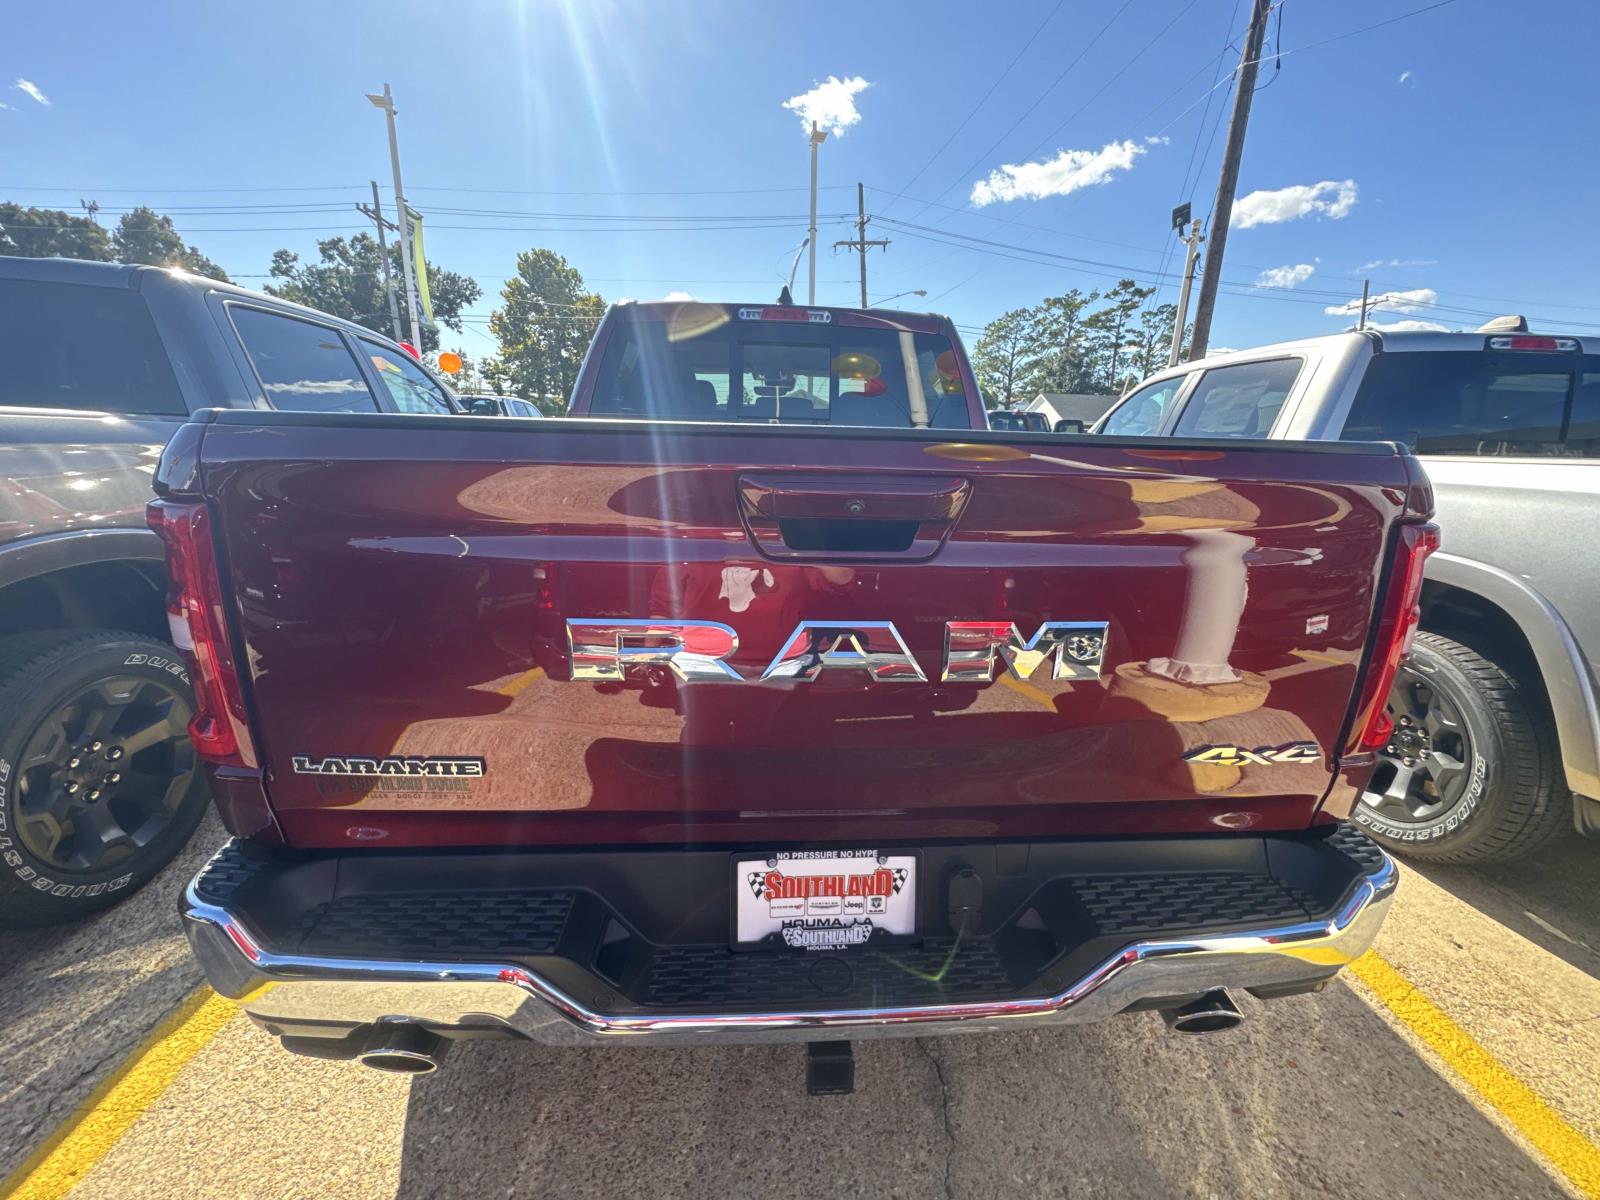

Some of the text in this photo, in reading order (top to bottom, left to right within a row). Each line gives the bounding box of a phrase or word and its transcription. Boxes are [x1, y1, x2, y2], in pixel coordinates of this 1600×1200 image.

[566, 617, 1110, 683] RAM
[292, 754, 486, 777] LARAMIE
[348, 776, 422, 791] SOUTHLAND
[1355, 754, 1486, 841] BRIDGESTONE
[776, 849, 878, 860] NO PRESSURE NO HYPE
[764, 869, 894, 902] SOUTHLAND
[845, 900, 864, 909] Jeep
[782, 917, 847, 928] HOUMA,
[792, 926, 864, 946] SOUTHLAND
